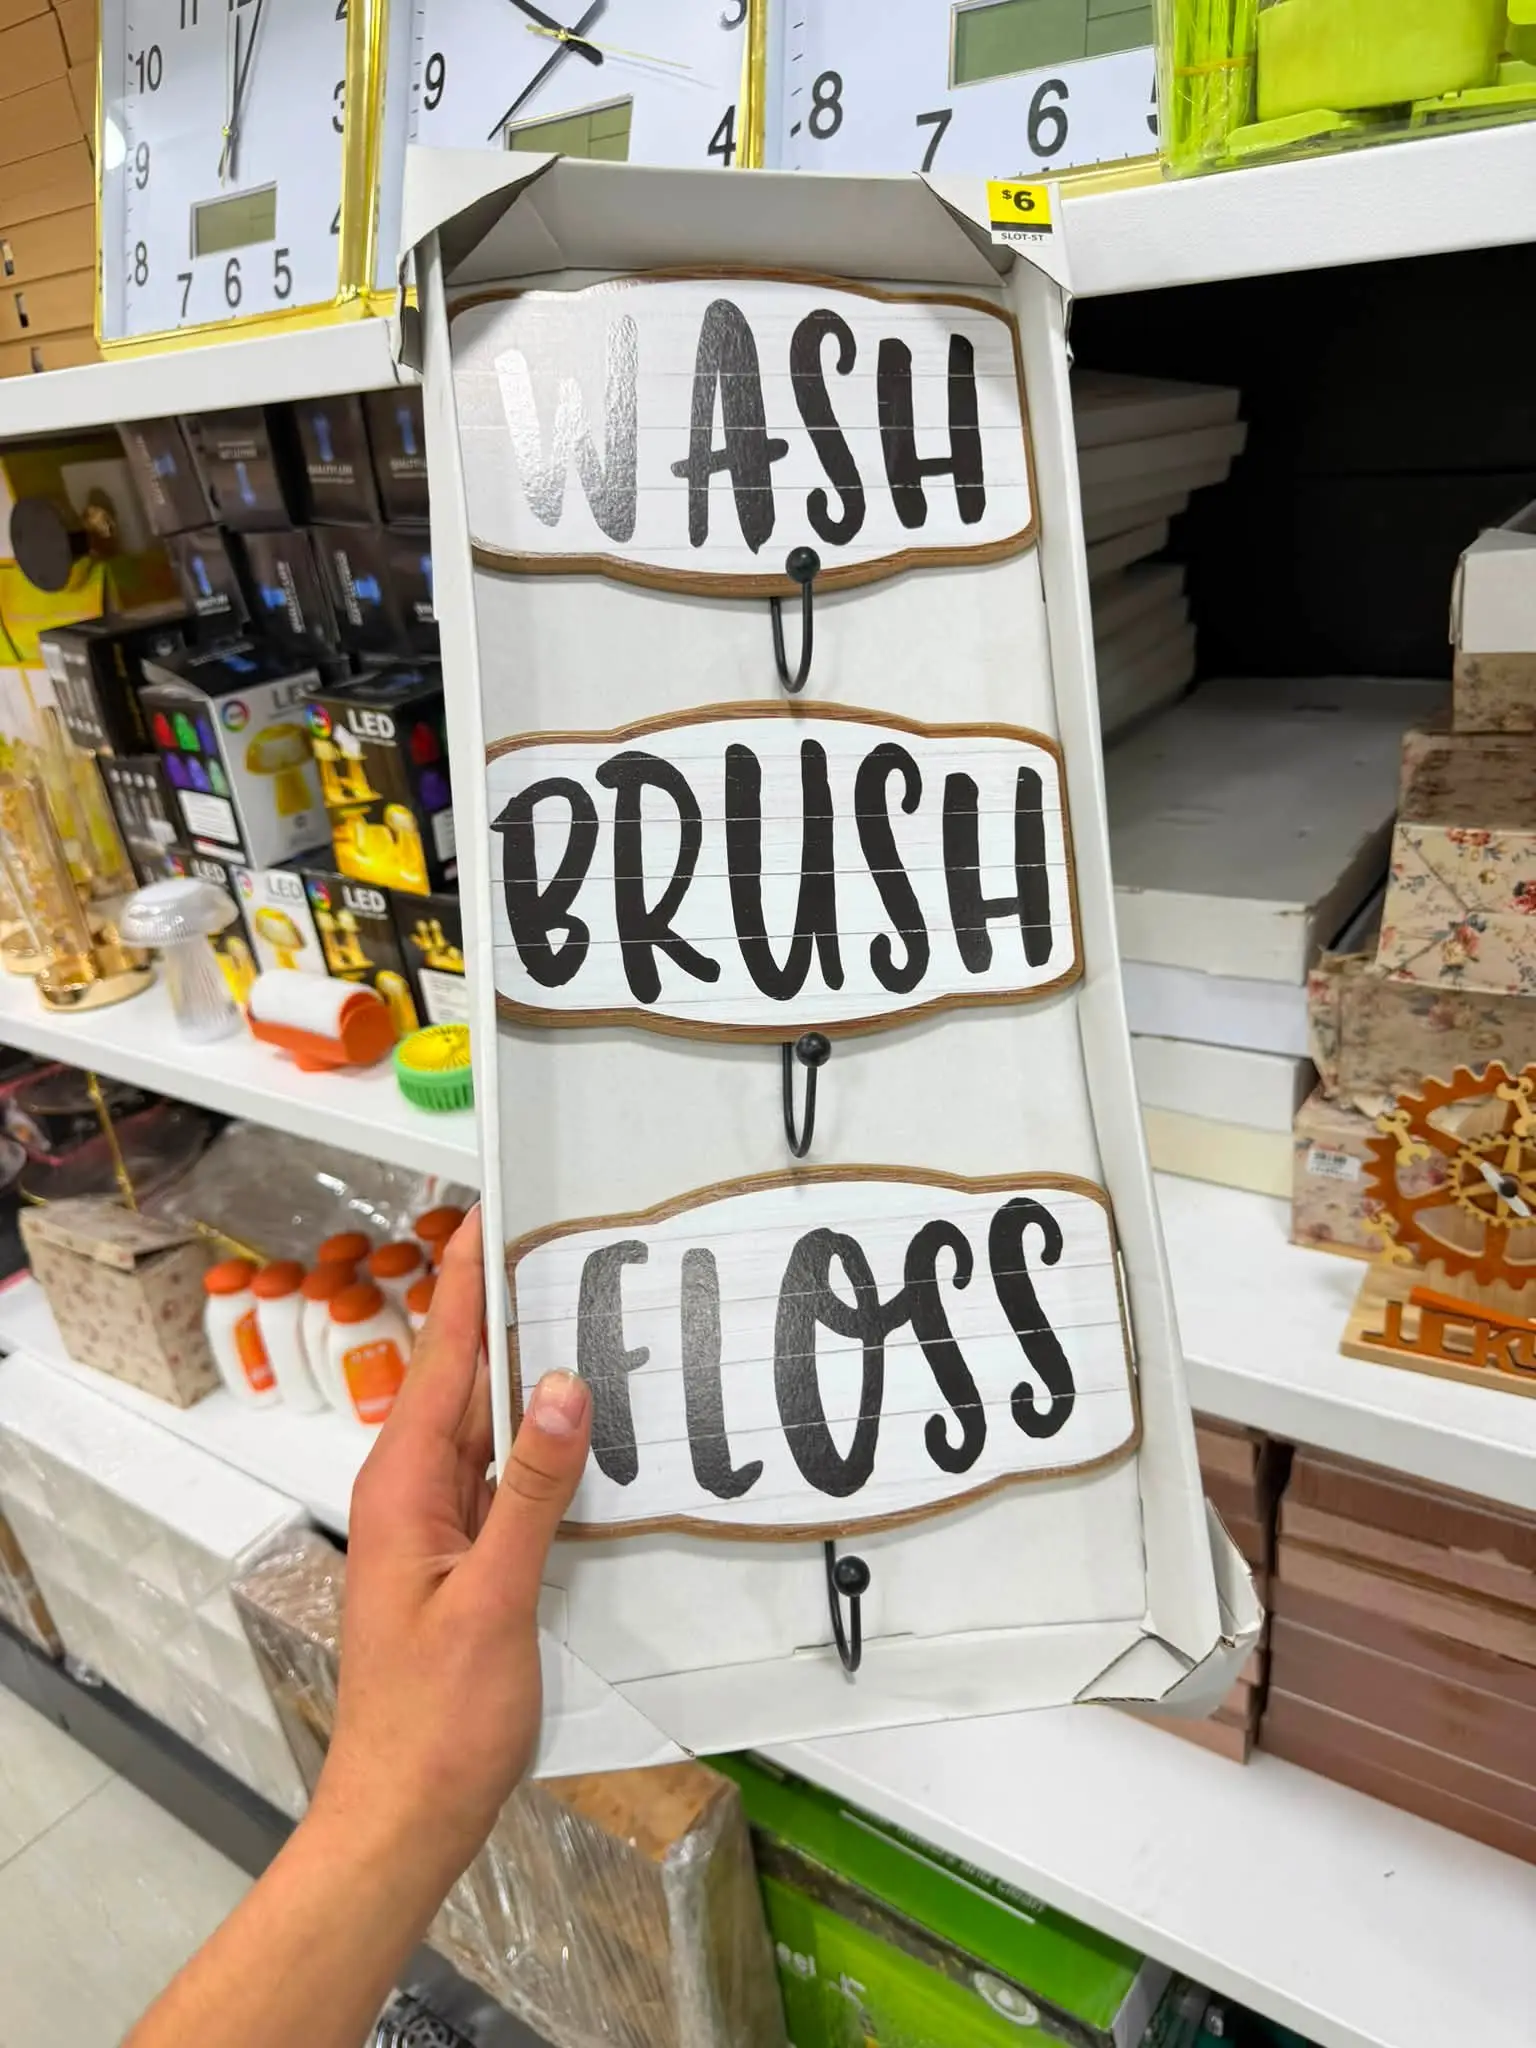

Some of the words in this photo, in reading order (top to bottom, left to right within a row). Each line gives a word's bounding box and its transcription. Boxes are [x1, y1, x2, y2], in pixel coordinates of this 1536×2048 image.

[135, 44, 162, 95] 10
[423, 52, 446, 111] 9
[808, 70, 843, 140] 8
[1026, 78, 1070, 158] 6
[707, 104, 738, 167] 4
[916, 108, 953, 173] 7
[135, 142, 150, 190] 9
[1001, 188, 1036, 212] $6
[135, 241, 149, 287] 8
[225, 257, 242, 309] 6
[274, 248, 292, 300] 5
[177, 272, 193, 318] 7
[494, 298, 987, 555] WASH
[345, 708, 397, 740] LED
[266, 874, 302, 901] LED
[489, 738, 1054, 1004] BRUSH
[341, 884, 388, 914] LED
[577, 1197, 1075, 1500] FLOSS
